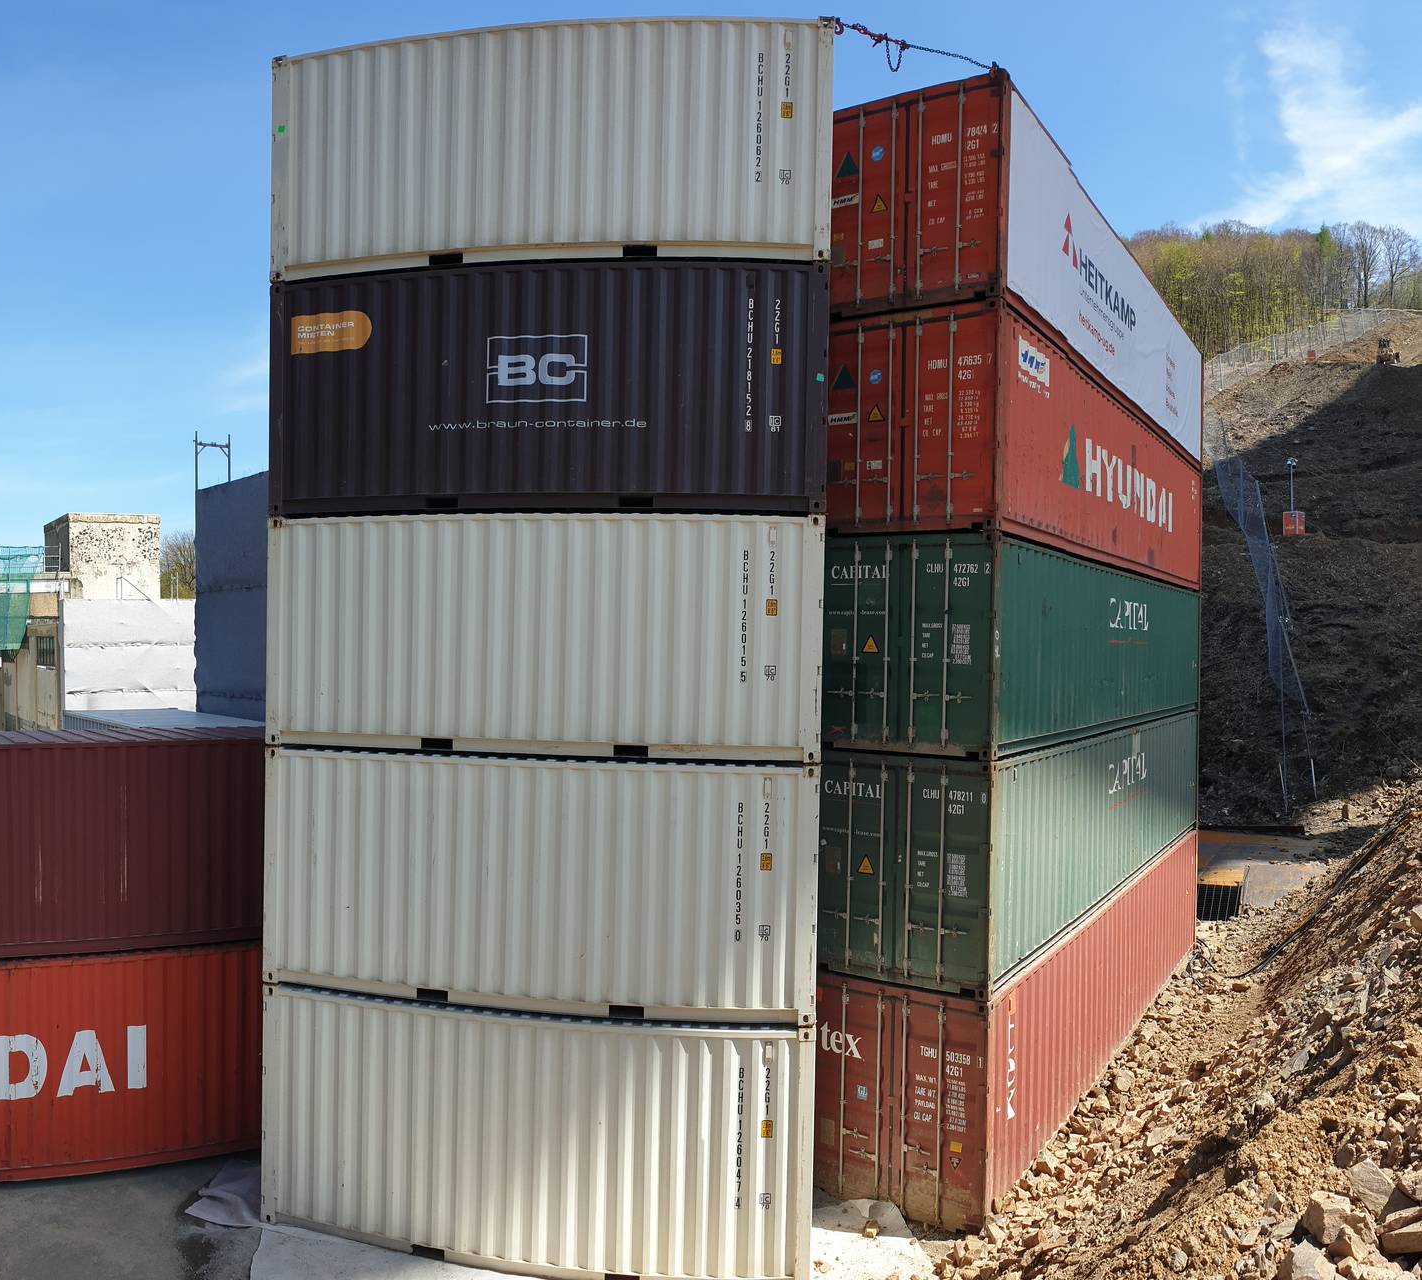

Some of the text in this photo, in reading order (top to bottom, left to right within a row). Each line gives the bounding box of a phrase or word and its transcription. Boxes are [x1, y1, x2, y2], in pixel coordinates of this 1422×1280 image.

[1079, 248, 1136, 331] HEITKAMP
[297, 321, 355, 332] CONTAINER
[297, 330, 335, 339] MIETEN
[497, 353, 576, 386] BC
[927, 358, 948, 370] HDMU
[428, 418, 647, 431] www.braun-container.de
[831, 415, 850, 423] HMM
[1085, 437, 1173, 534] HYUNDAI
[927, 563, 944, 573] CLHU
[953, 563, 979, 574] 472762
[984, 563, 991, 575] 2
[953, 577, 970, 587] 42G1
[923, 789, 940, 800] CLHU
[949, 790, 973, 802] 478211
[948, 804, 964, 815] 42G1
[820, 1021, 862, 1059] tex
[920, 1045, 938, 1059] TGHU
[946, 1051, 971, 1066] 503358
[946, 1065, 963, 1078] 42G1
[737, 1067, 745, 1115] BCHU
[914, 1086, 926, 1097] TARE
[914, 1099, 935, 1109] PAYLOAD
